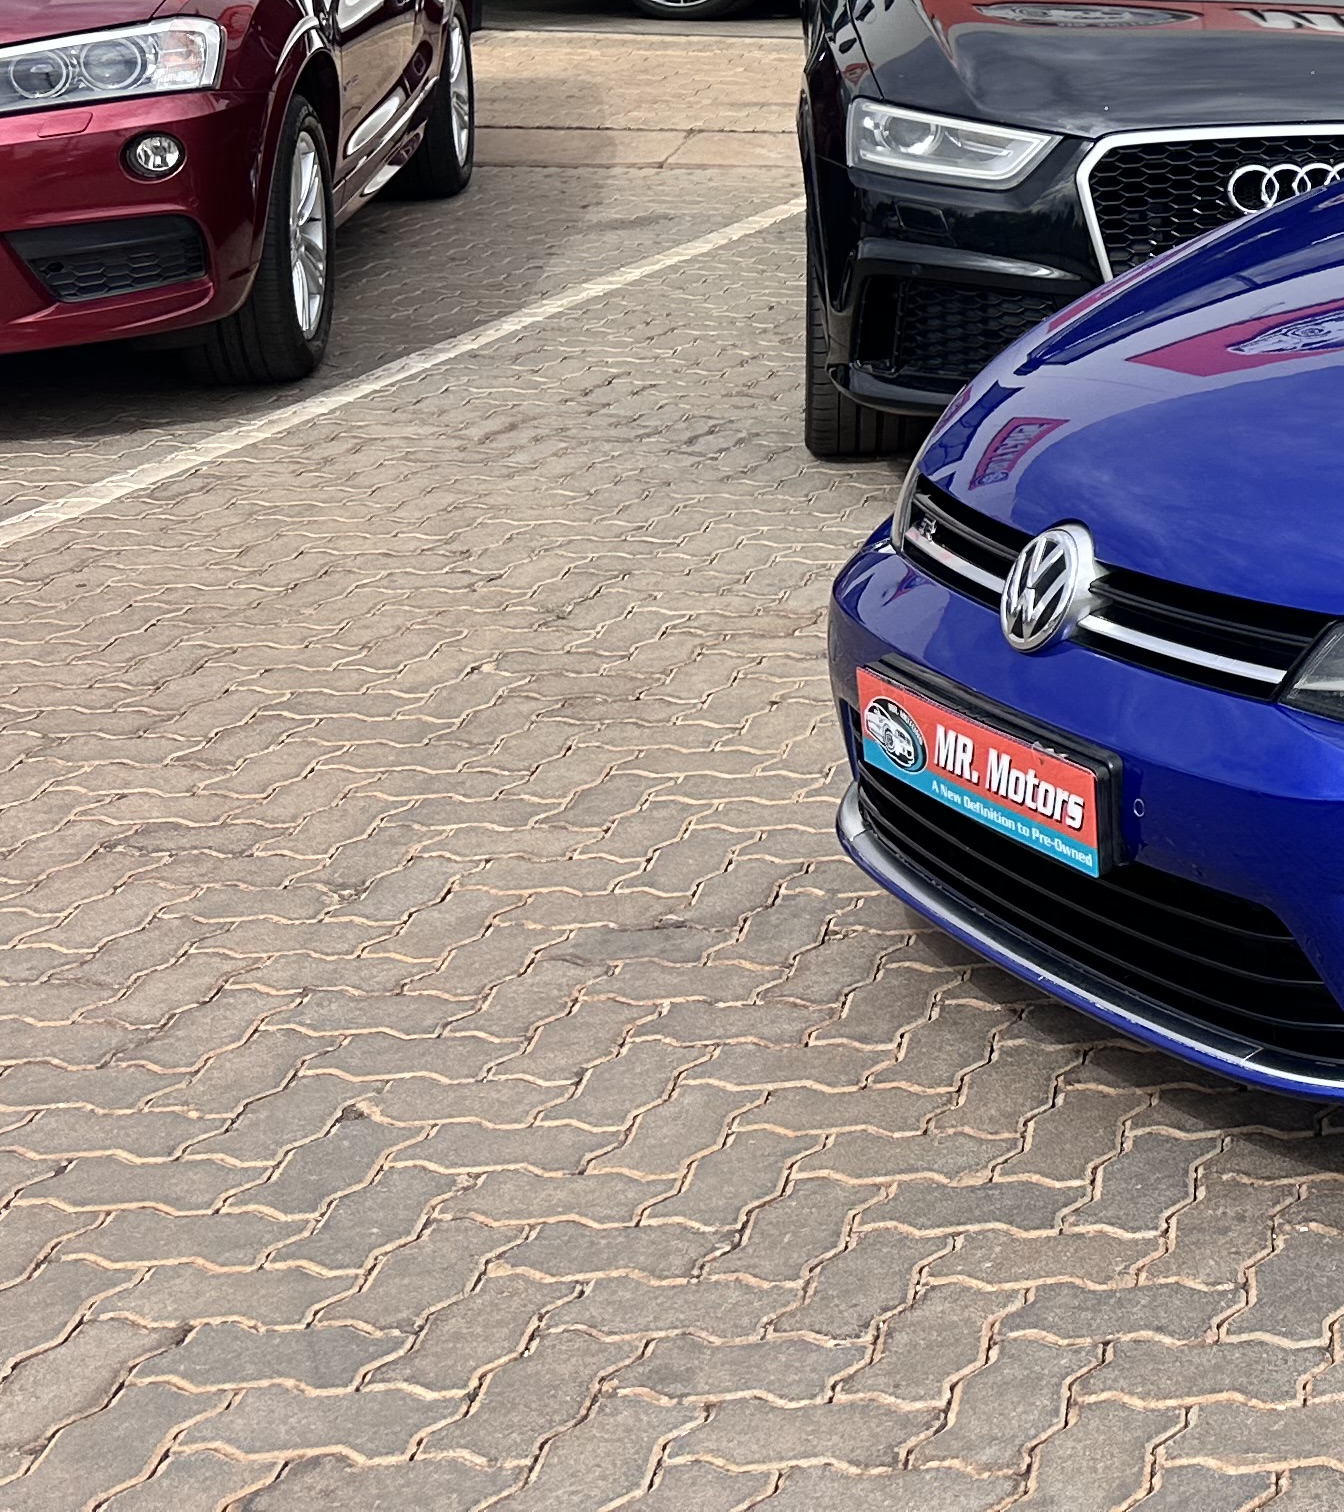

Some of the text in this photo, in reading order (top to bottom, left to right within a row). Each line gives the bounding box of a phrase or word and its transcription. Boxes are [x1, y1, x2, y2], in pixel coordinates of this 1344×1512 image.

[931, 779, 1093, 869] A New Definition to Pre-Owned
[933, 723, 1085, 831] MR. Motors
